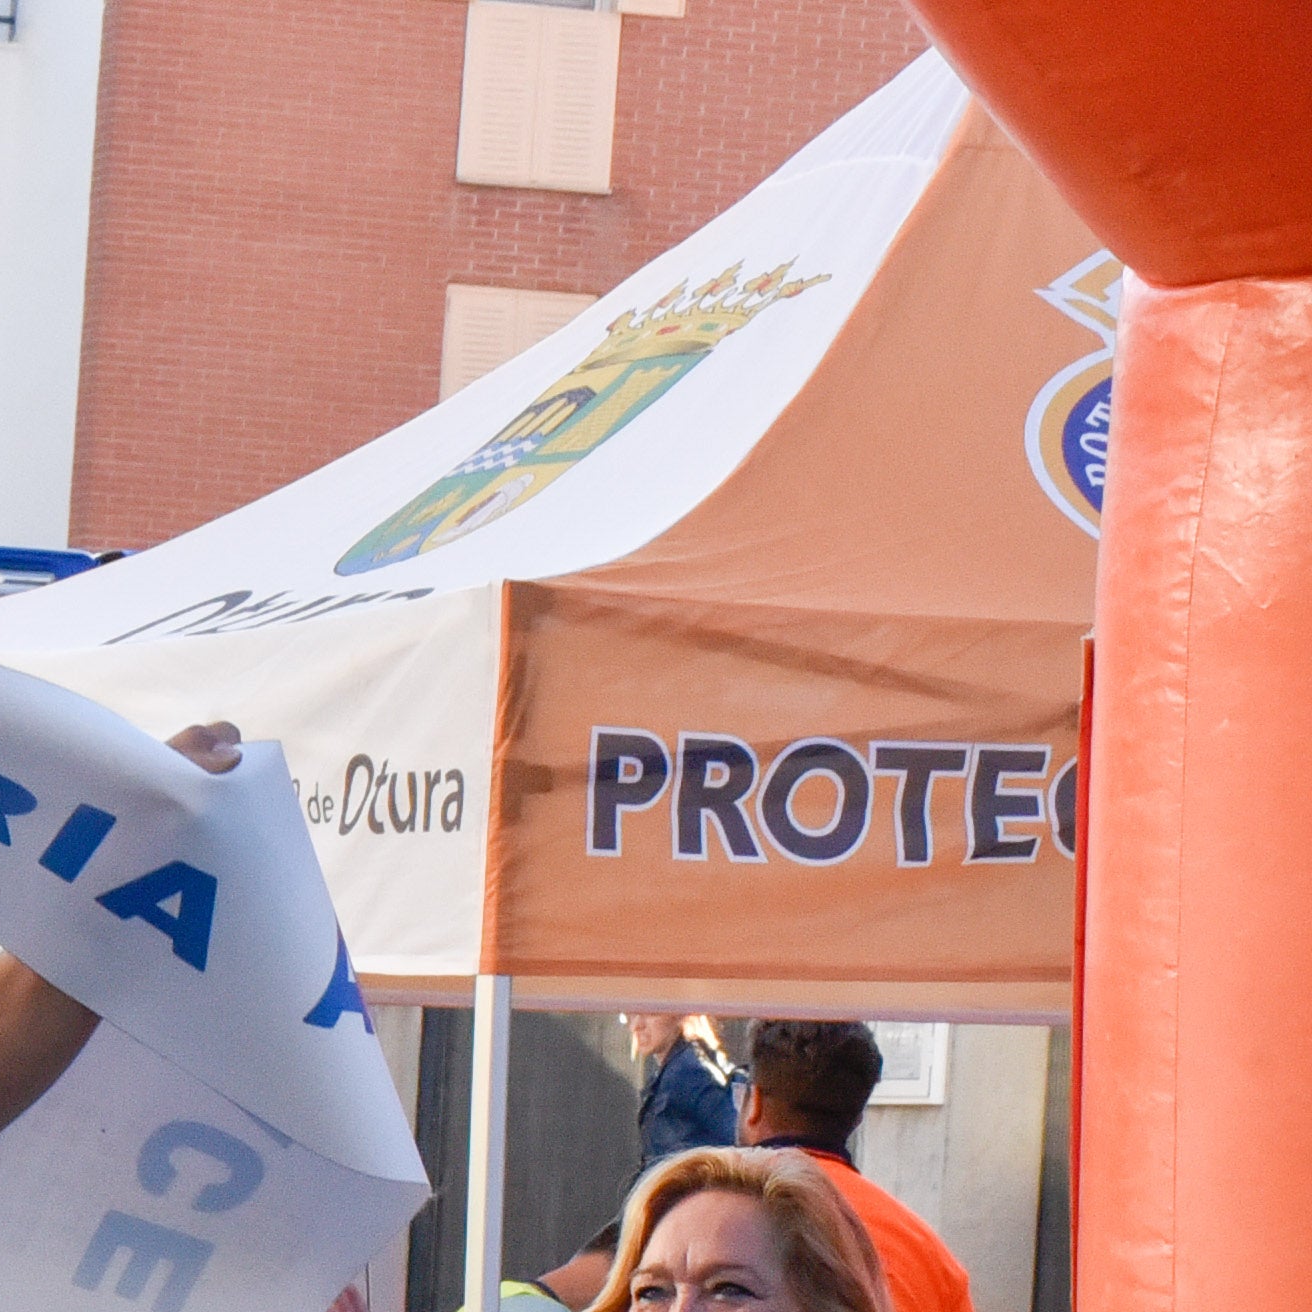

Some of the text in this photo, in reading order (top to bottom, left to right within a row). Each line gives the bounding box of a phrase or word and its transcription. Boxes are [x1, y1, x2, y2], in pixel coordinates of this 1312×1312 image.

[307, 752, 465, 836] de Otura
[586, 724, 1077, 868] PROTE
